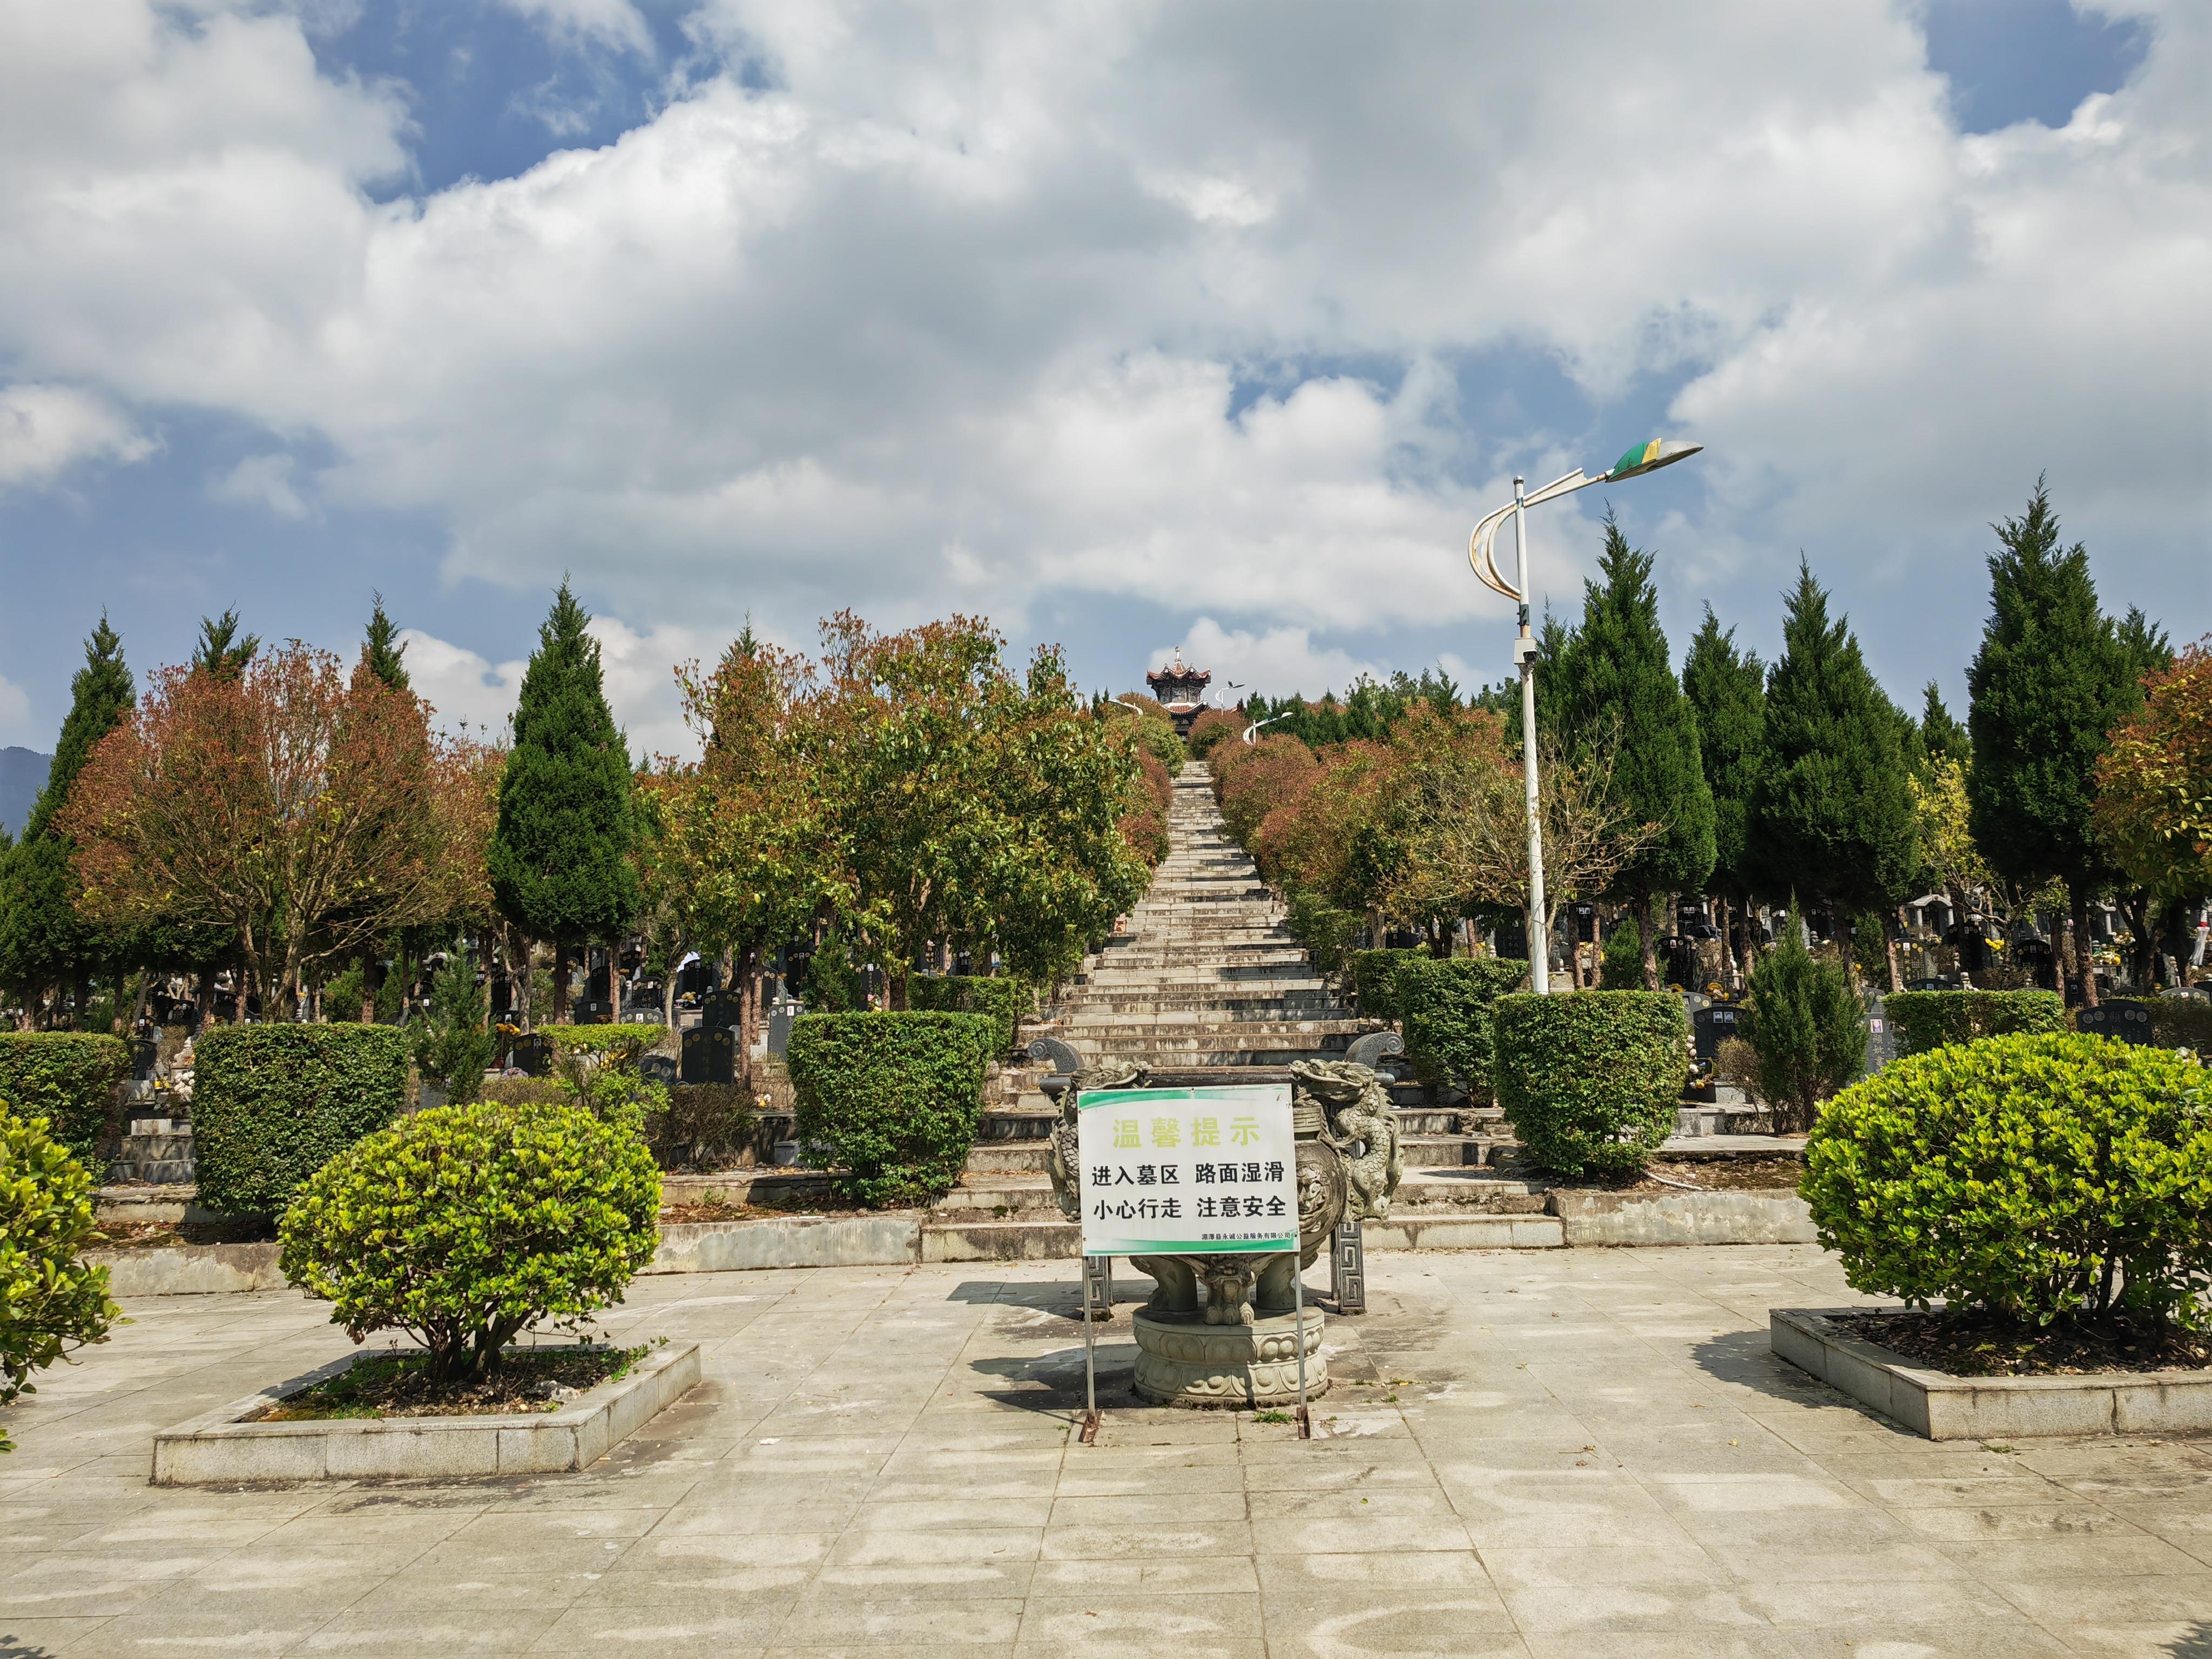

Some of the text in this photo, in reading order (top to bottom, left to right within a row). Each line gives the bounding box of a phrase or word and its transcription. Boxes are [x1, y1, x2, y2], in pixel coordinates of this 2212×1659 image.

[1112, 1117, 1260, 1148] 温馨提示
[1092, 1161, 1284, 1186] 进入墓区 路面湿滑
[1094, 1195, 1286, 1220] 小心行走 注意安全
[1202, 1232, 1291, 1240] 湄潭县永诚公益服务有限公司
